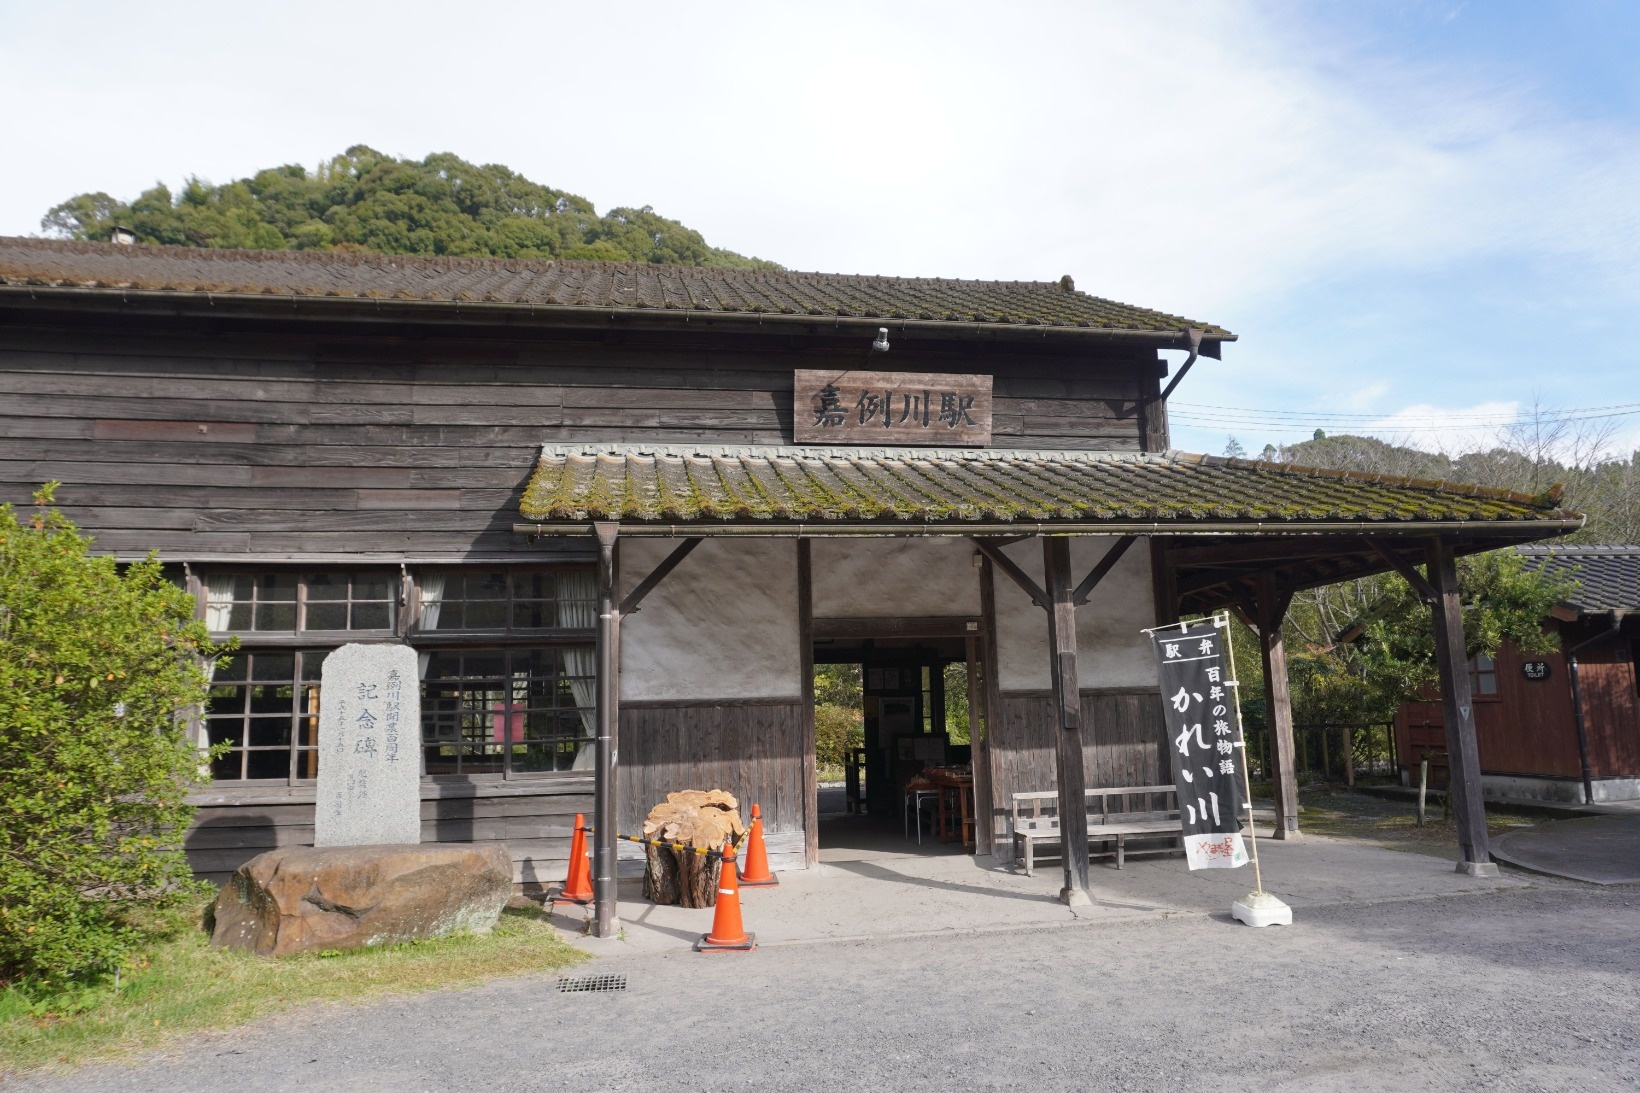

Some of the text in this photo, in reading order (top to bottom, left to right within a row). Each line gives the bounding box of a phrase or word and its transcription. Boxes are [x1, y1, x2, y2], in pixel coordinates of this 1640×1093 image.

[813, 384, 977, 429] 嘉例川駅
[354, 682, 378, 758] 記念碑
[385, 669, 402, 763] 嘉例川駅開業百周年
[1170, 686, 1221, 826] かれい川
[1205, 667, 1235, 775] 百年の旅物語
